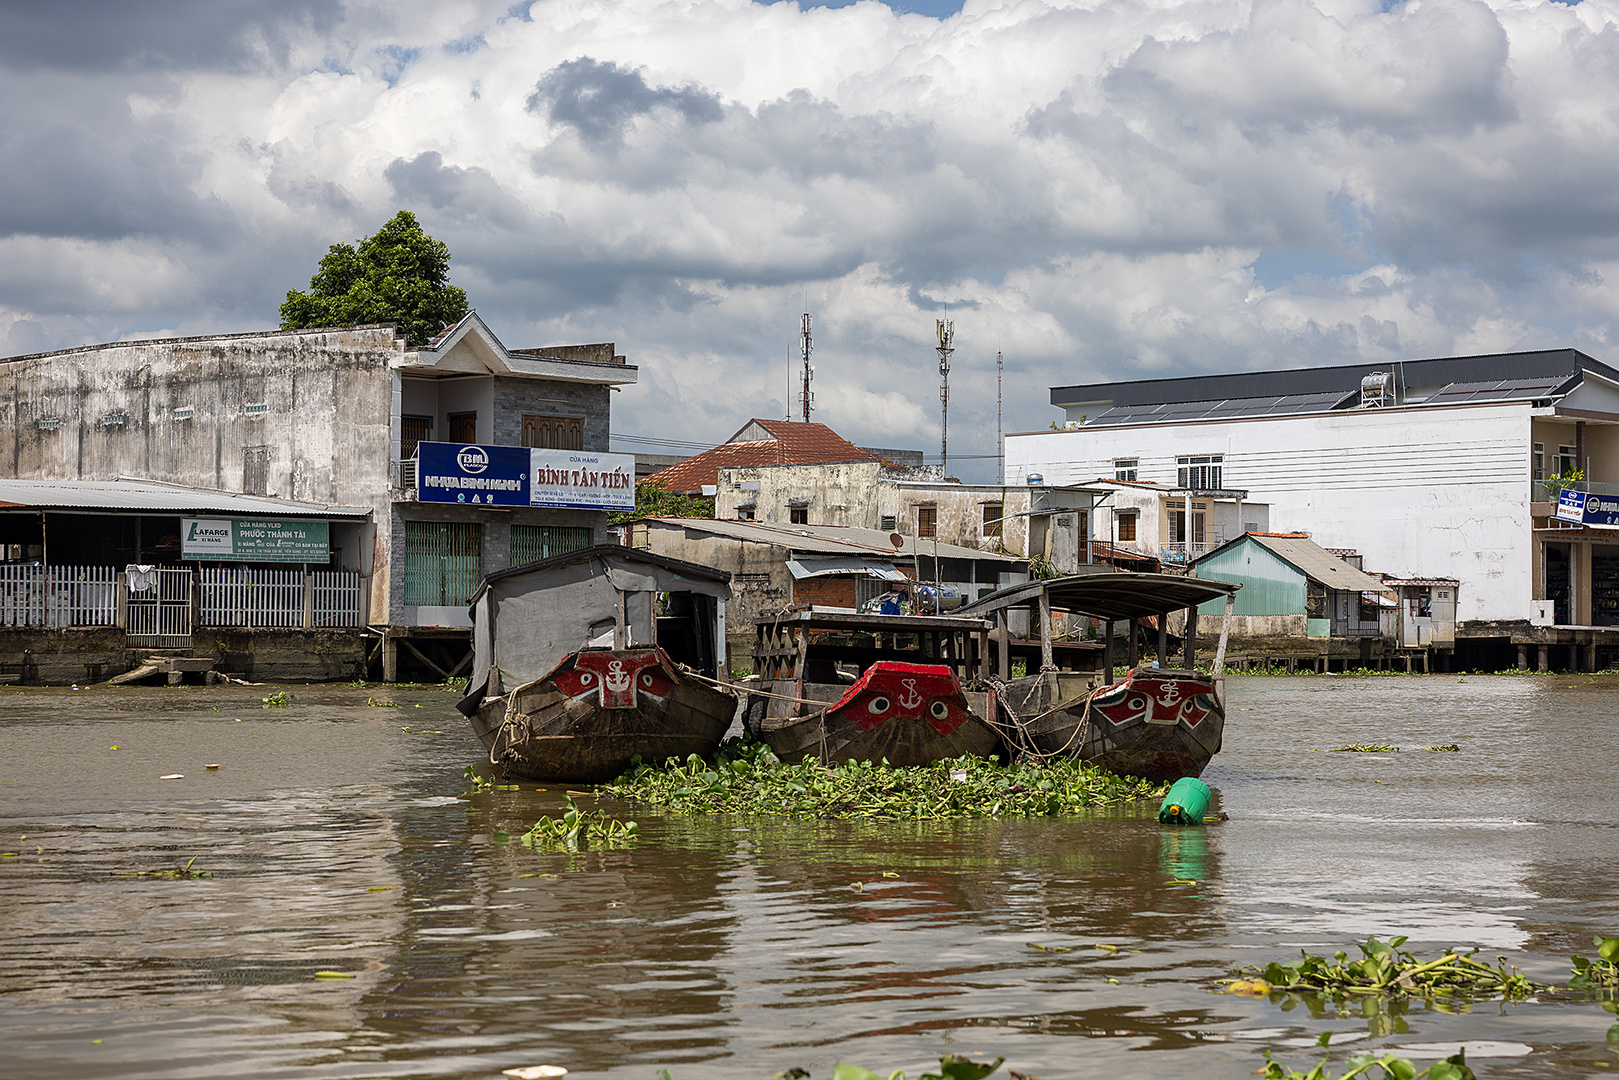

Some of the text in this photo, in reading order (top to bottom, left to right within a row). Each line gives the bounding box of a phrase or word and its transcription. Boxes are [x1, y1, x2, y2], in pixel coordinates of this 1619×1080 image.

[463, 454, 485, 464] BM
[569, 455, 581, 463] CỬA
[537, 463, 630, 489] BÌNH TÂN TIẾN
[425, 475, 460, 491] NHỰA
[239, 520, 251, 528] CỬA
[240, 529, 306, 539] PHƯỚC THÀNH TÀI
